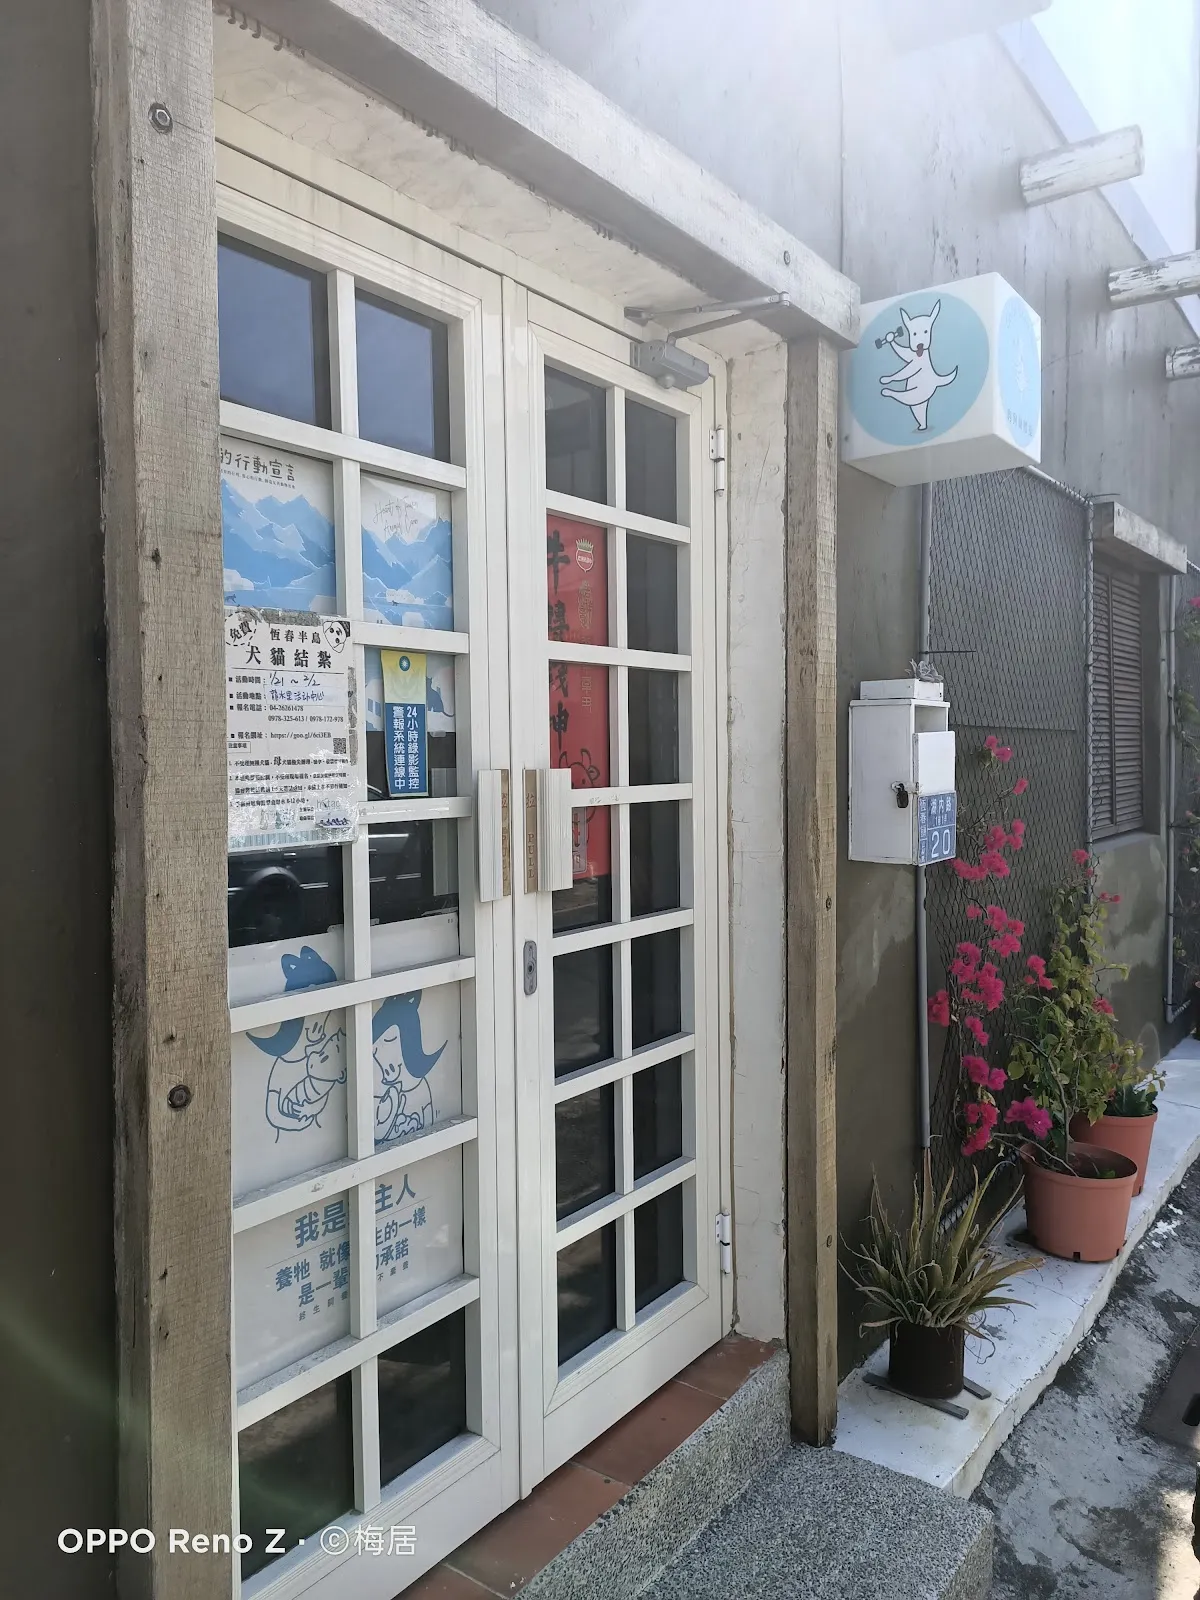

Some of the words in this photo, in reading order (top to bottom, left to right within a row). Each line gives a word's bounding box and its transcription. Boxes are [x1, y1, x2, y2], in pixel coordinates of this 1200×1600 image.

[229, 620, 253, 643] 免費
[269, 628, 322, 645] 恆春半島
[245, 645, 332, 669] 犬貓結紮
[392, 706, 406, 790] 警報系統連線中
[406, 706, 420, 789] 24小時錄影監控
[527, 833, 535, 878] PULL
[931, 828, 951, 859] 20
